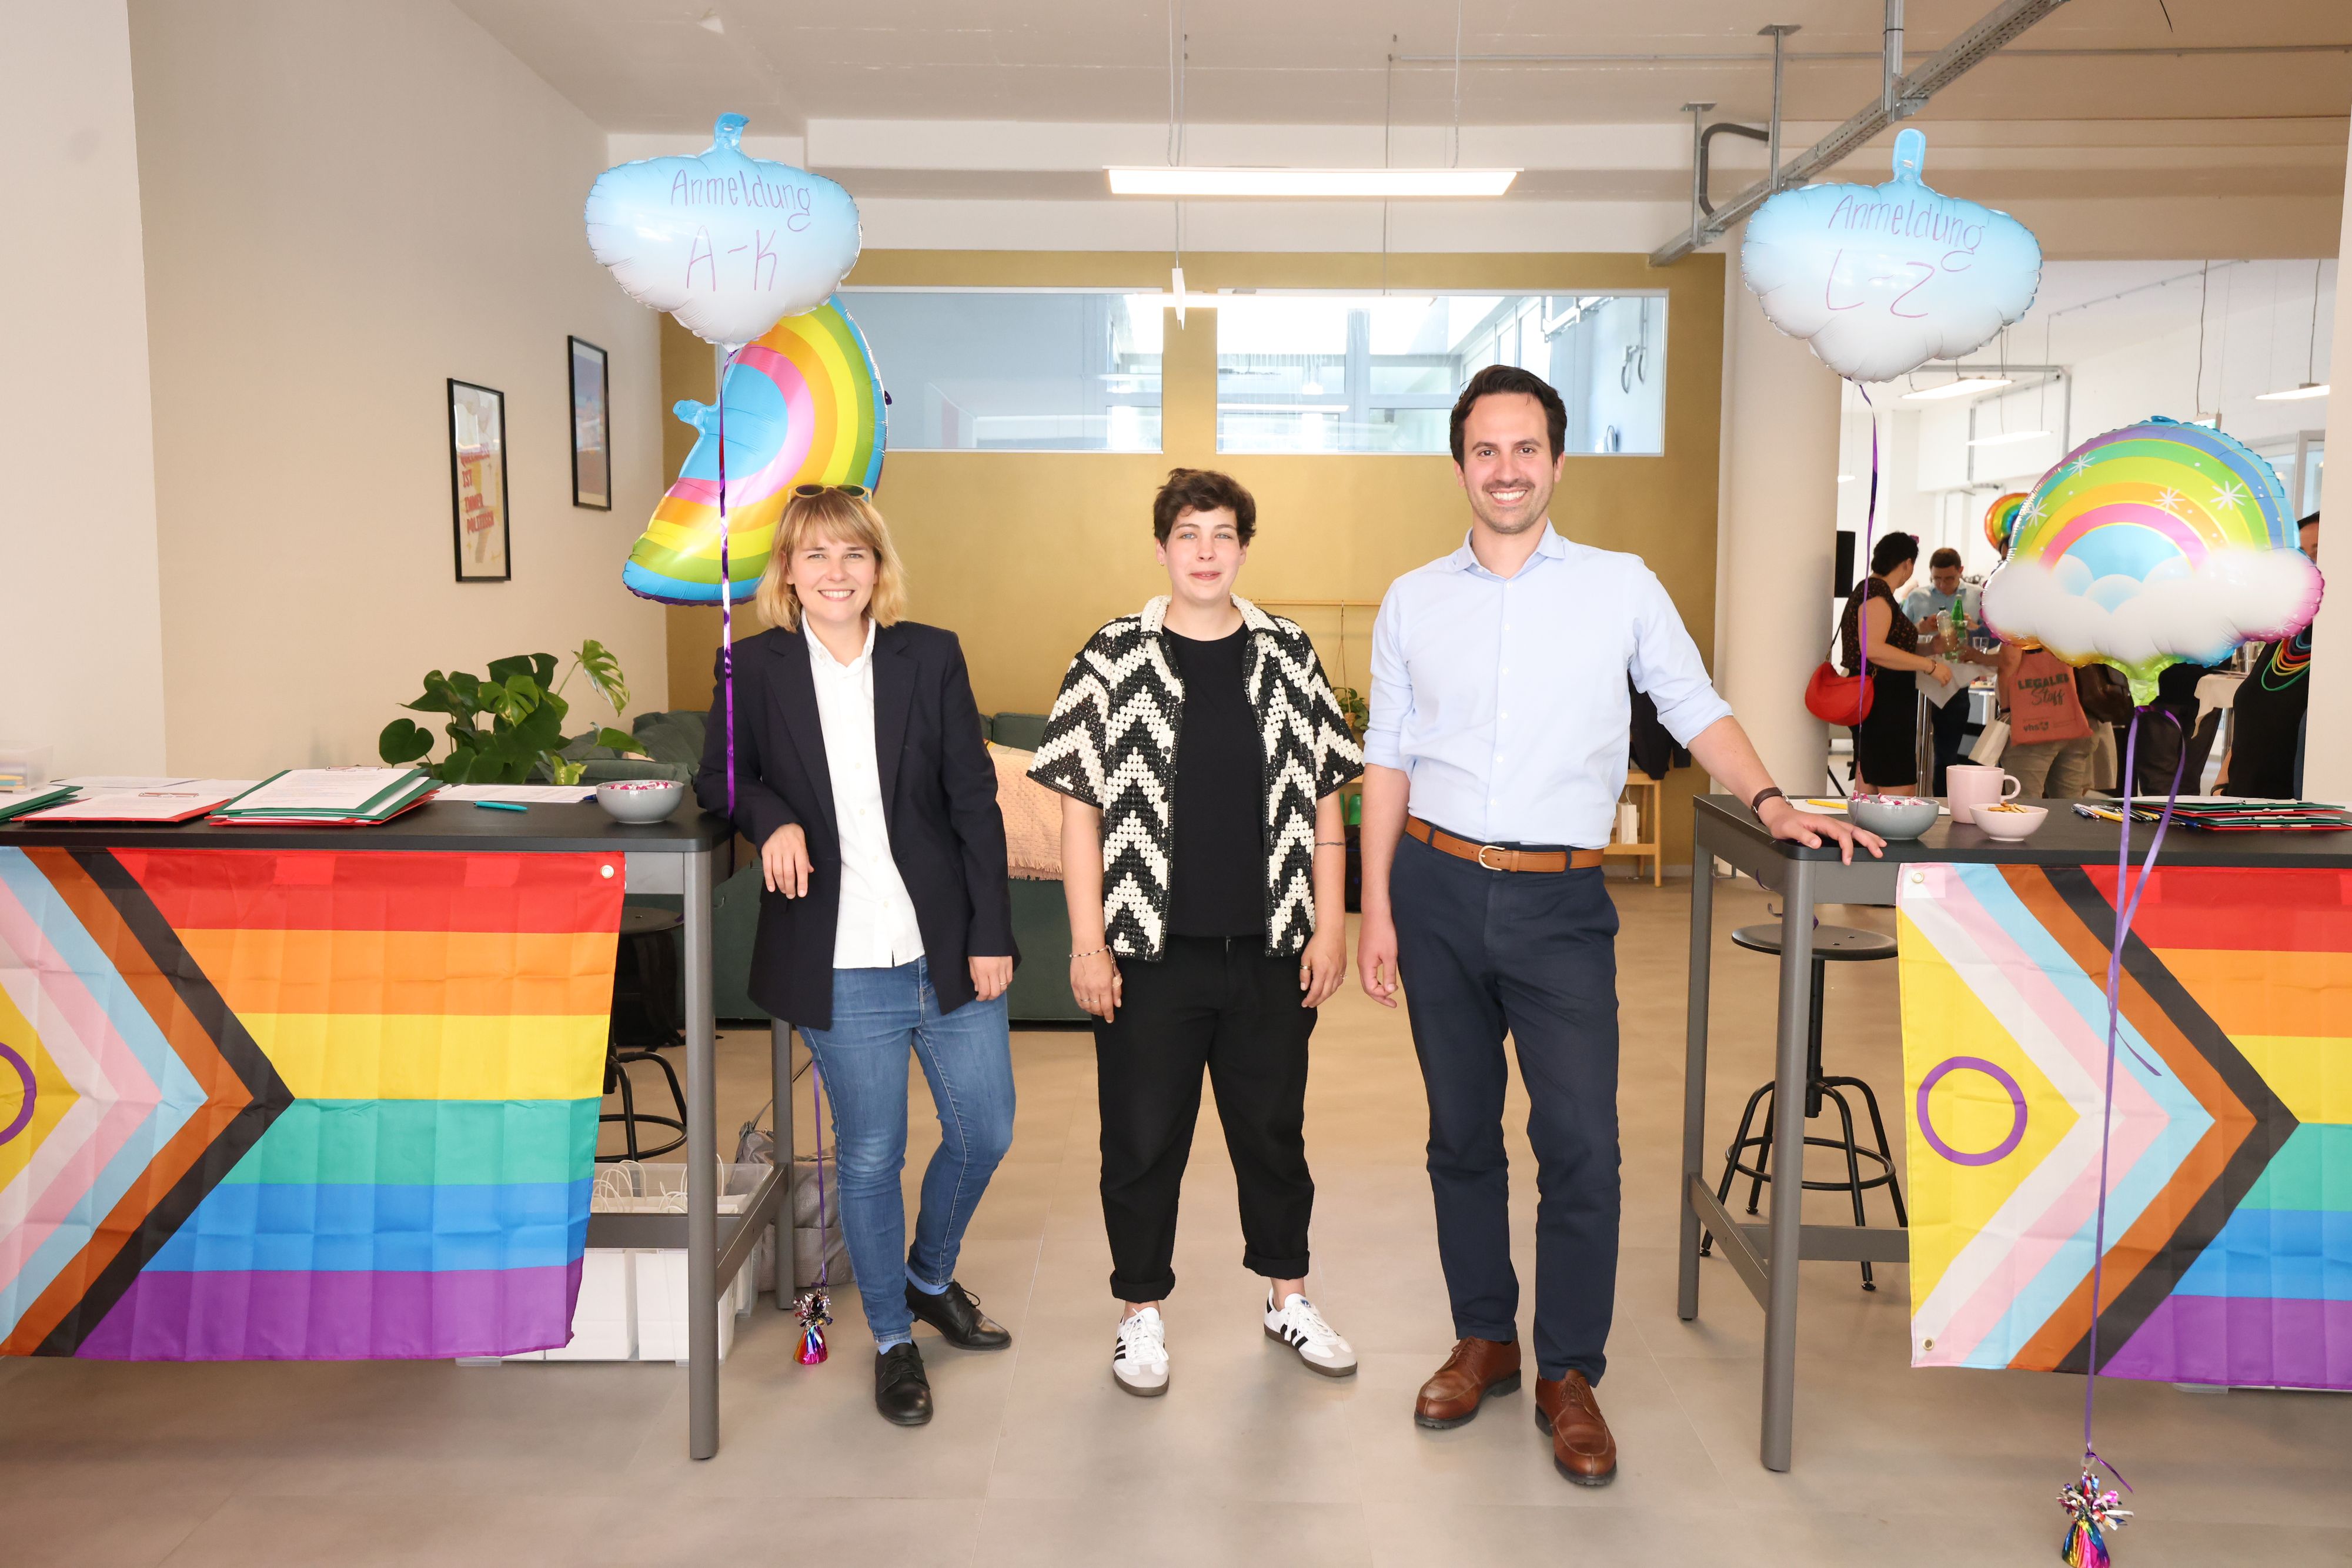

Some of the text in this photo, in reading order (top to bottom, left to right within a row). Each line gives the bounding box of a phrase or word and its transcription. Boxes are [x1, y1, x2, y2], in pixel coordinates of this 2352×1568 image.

[671, 169, 811, 232] Anmeldung
[1828, 195, 1986, 272] Anmeldung
[462, 469, 473, 487] IST
[467, 511, 494, 534] POLITISCH
[2023, 724, 2039, 732] vhs
